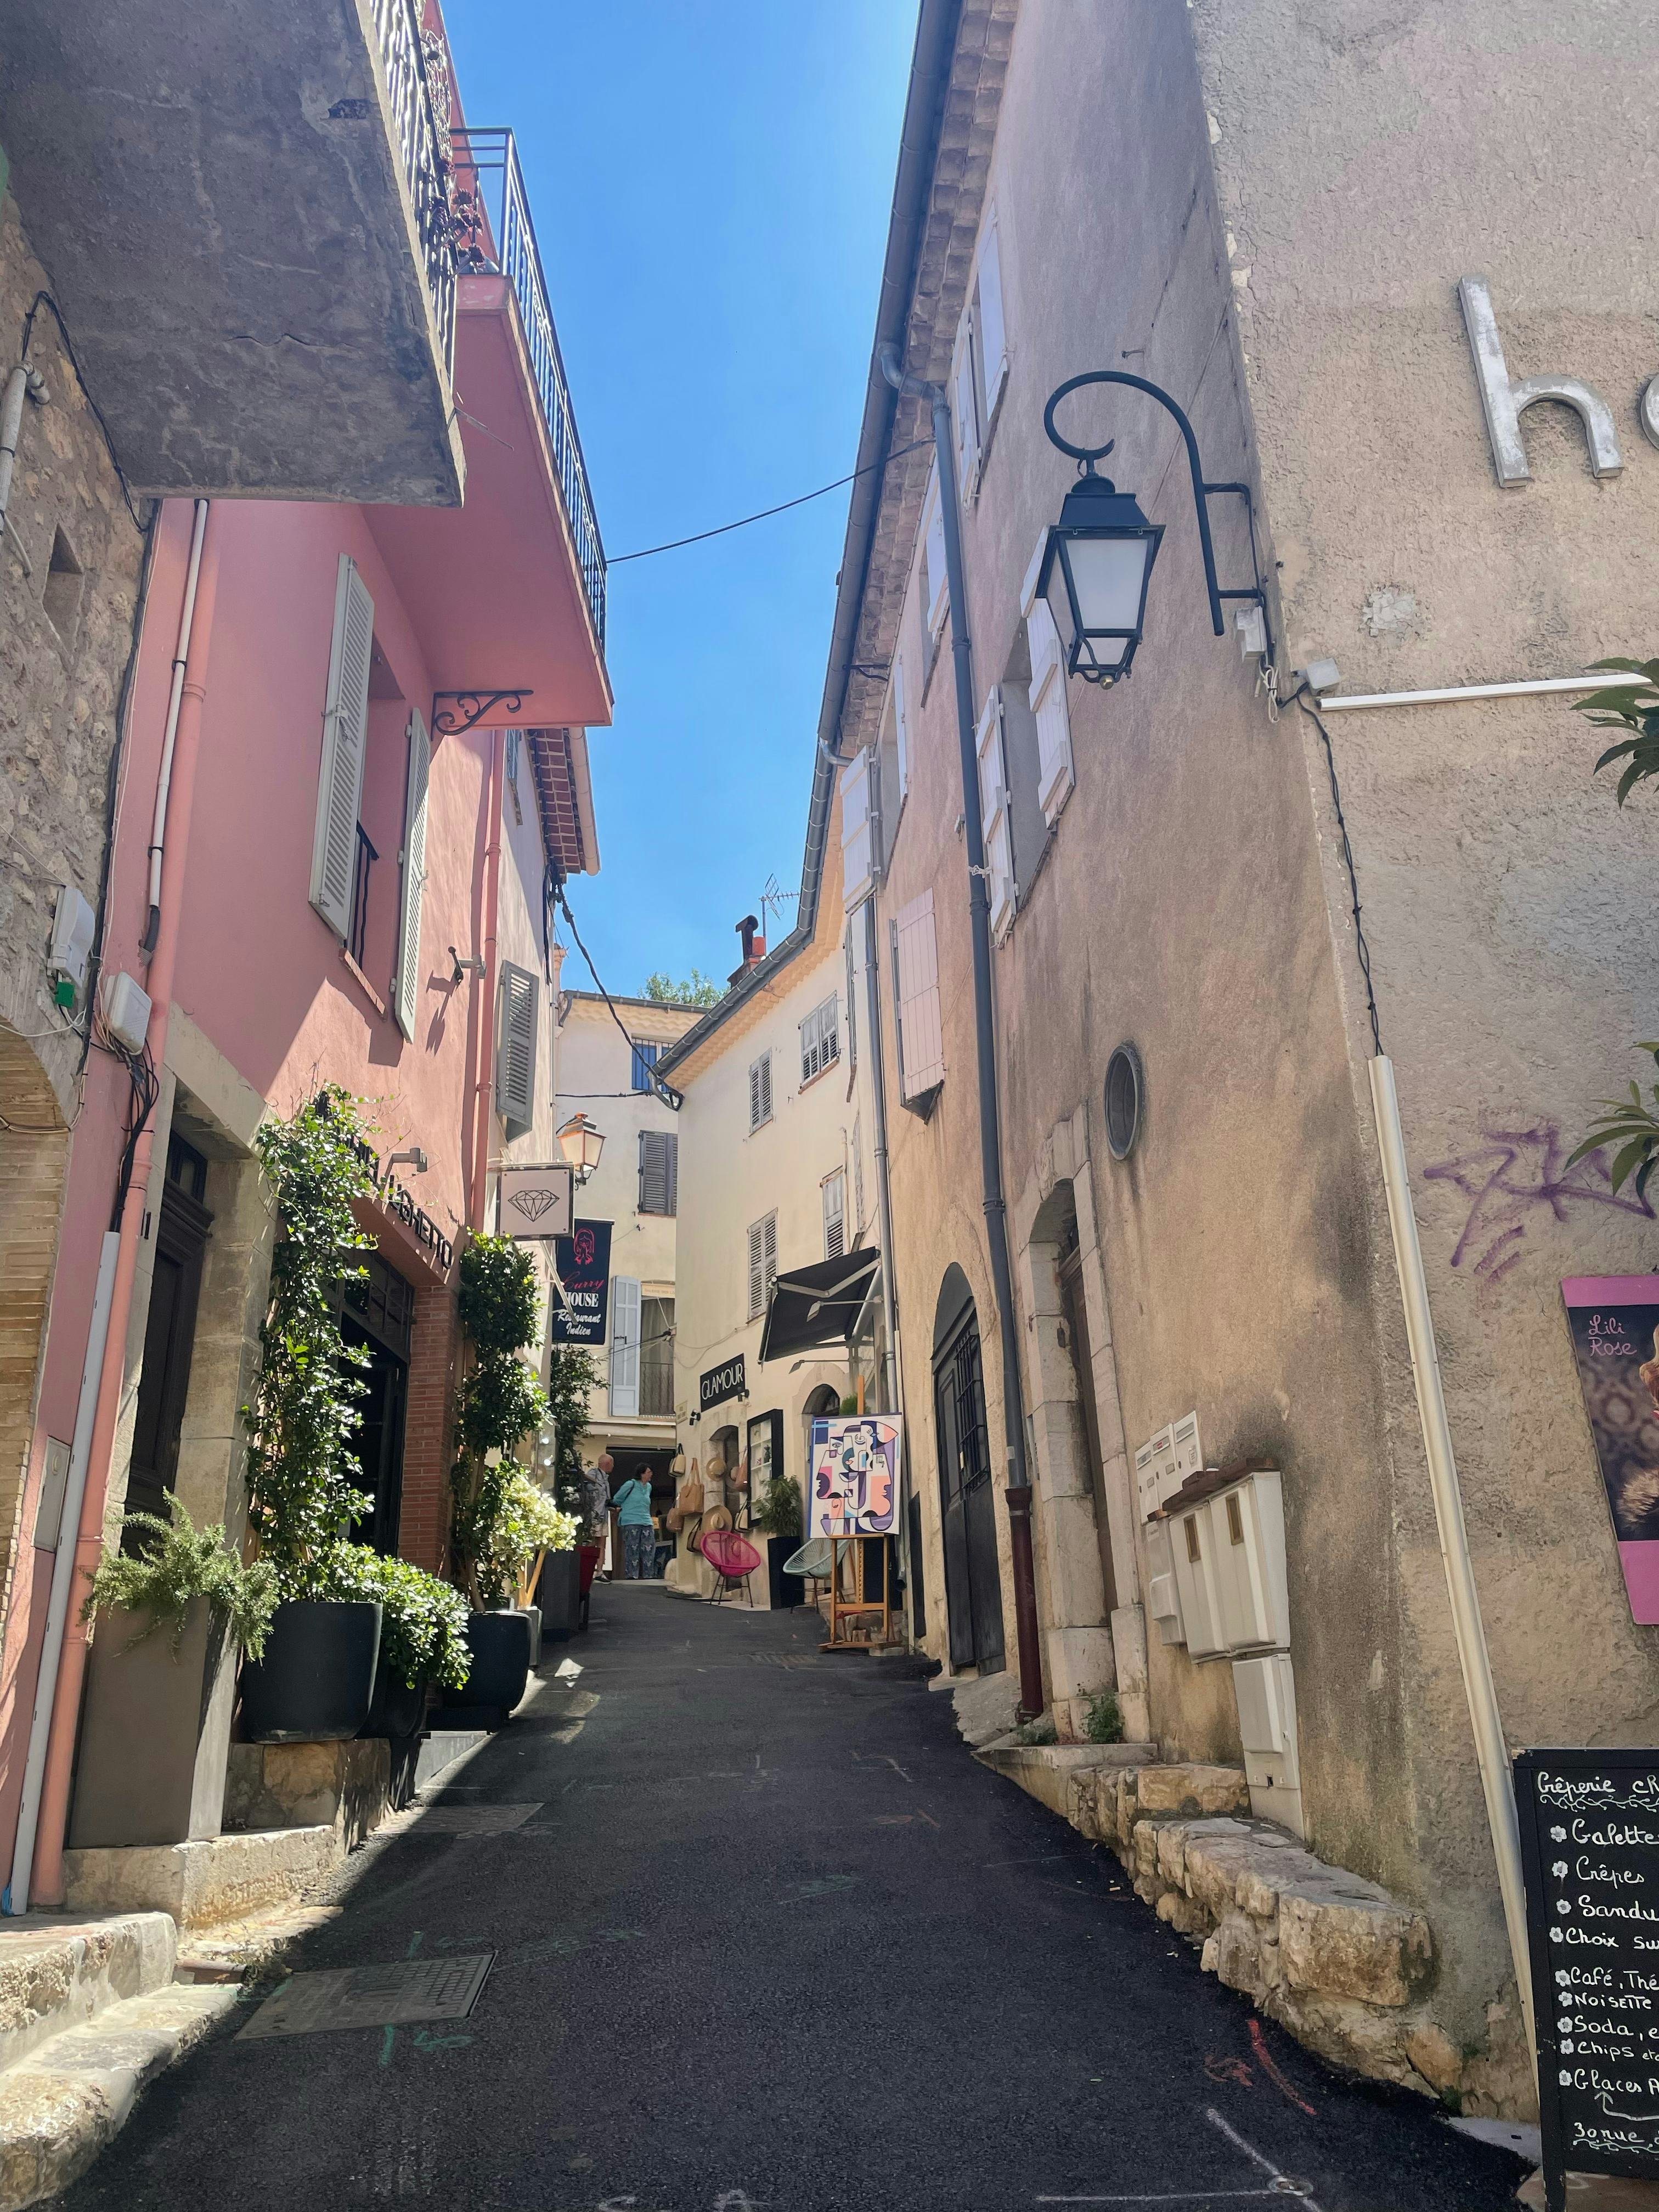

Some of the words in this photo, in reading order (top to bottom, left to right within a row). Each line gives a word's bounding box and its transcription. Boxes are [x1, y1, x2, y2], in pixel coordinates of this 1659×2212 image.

[566, 1322, 591, 1335] Indien
[1588, 1314, 1626, 1335] Lili
[1588, 1336, 1638, 1356] Rose
[701, 1363, 743, 1400] GLAMOUR
[1537, 1771, 1616, 1802] Crêperie
[1572, 1818, 1659, 1845] Galette
[1576, 1855, 1645, 1889] Crêpes
[1566, 1927, 1619, 1948] Choix
[1623, 1971, 1659, 1991] Thé
[1577, 2041, 1634, 2062] Chips
[1574, 2068, 1643, 2093] Glaces
